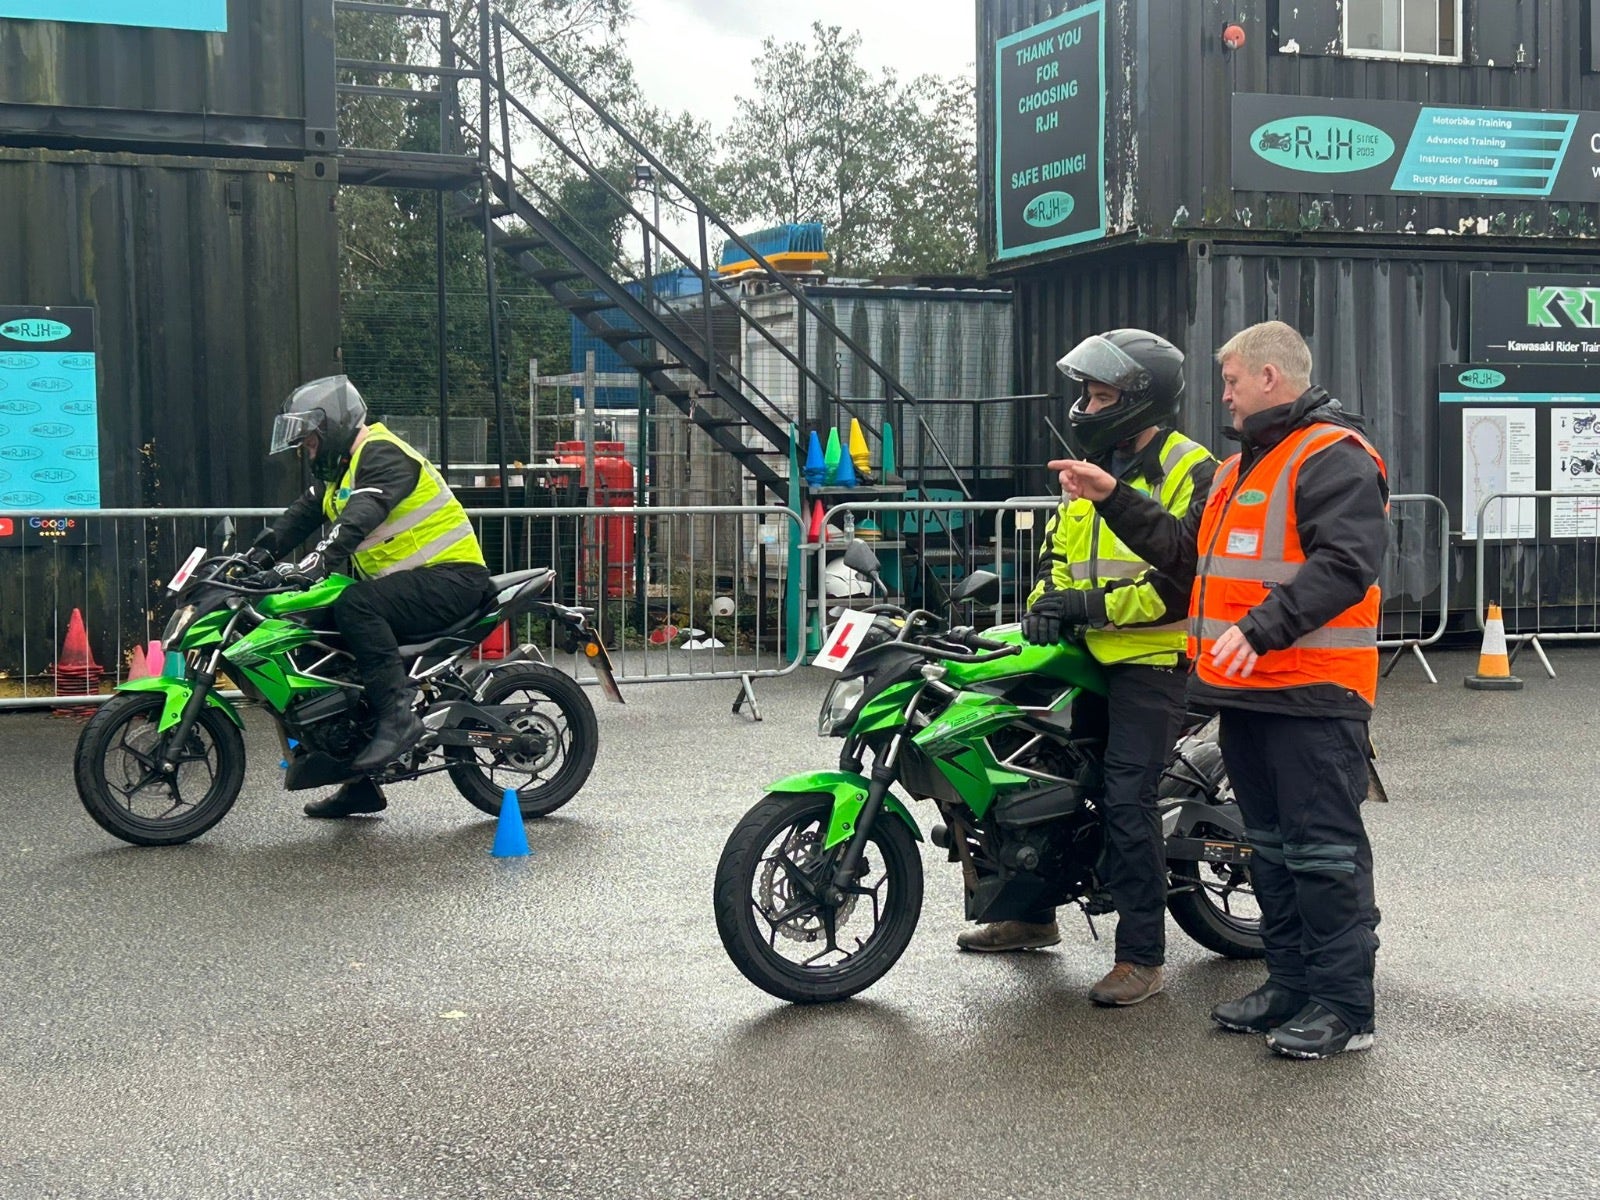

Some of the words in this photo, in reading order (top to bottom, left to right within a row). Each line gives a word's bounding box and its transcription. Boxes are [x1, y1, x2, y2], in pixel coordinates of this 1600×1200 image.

[1016, 37, 1054, 66] THANK
[1057, 26, 1081, 51] YOU
[1036, 61, 1059, 83] FOR
[1018, 79, 1078, 114] CHOOSING
[1036, 111, 1058, 133] RJH
[1432, 116, 1476, 126] Motorbike
[1478, 118, 1512, 129] Training
[1295, 125, 1352, 161] RJH
[1426, 136, 1469, 145] Advanced
[1470, 137, 1506, 148] Training
[1356, 147, 1375, 157] 2003
[1419, 154, 1461, 164] Instructor
[1464, 156, 1499, 167] Training
[1011, 167, 1039, 190] SAFE
[1042, 153, 1086, 181] RIDING!
[1413, 174, 1437, 185] Rusty
[1439, 175, 1461, 184] Rider
[1464, 176, 1498, 186] Courses
[1038, 198, 1060, 221] RJH
[21, 323, 50, 337] RJH
[1508, 340, 1554, 352] Kawasaki
[1556, 341, 1579, 352] Rider
[1473, 372, 1492, 384] RJH
[29, 517, 75, 531] Google
[828, 622, 855, 658] L
